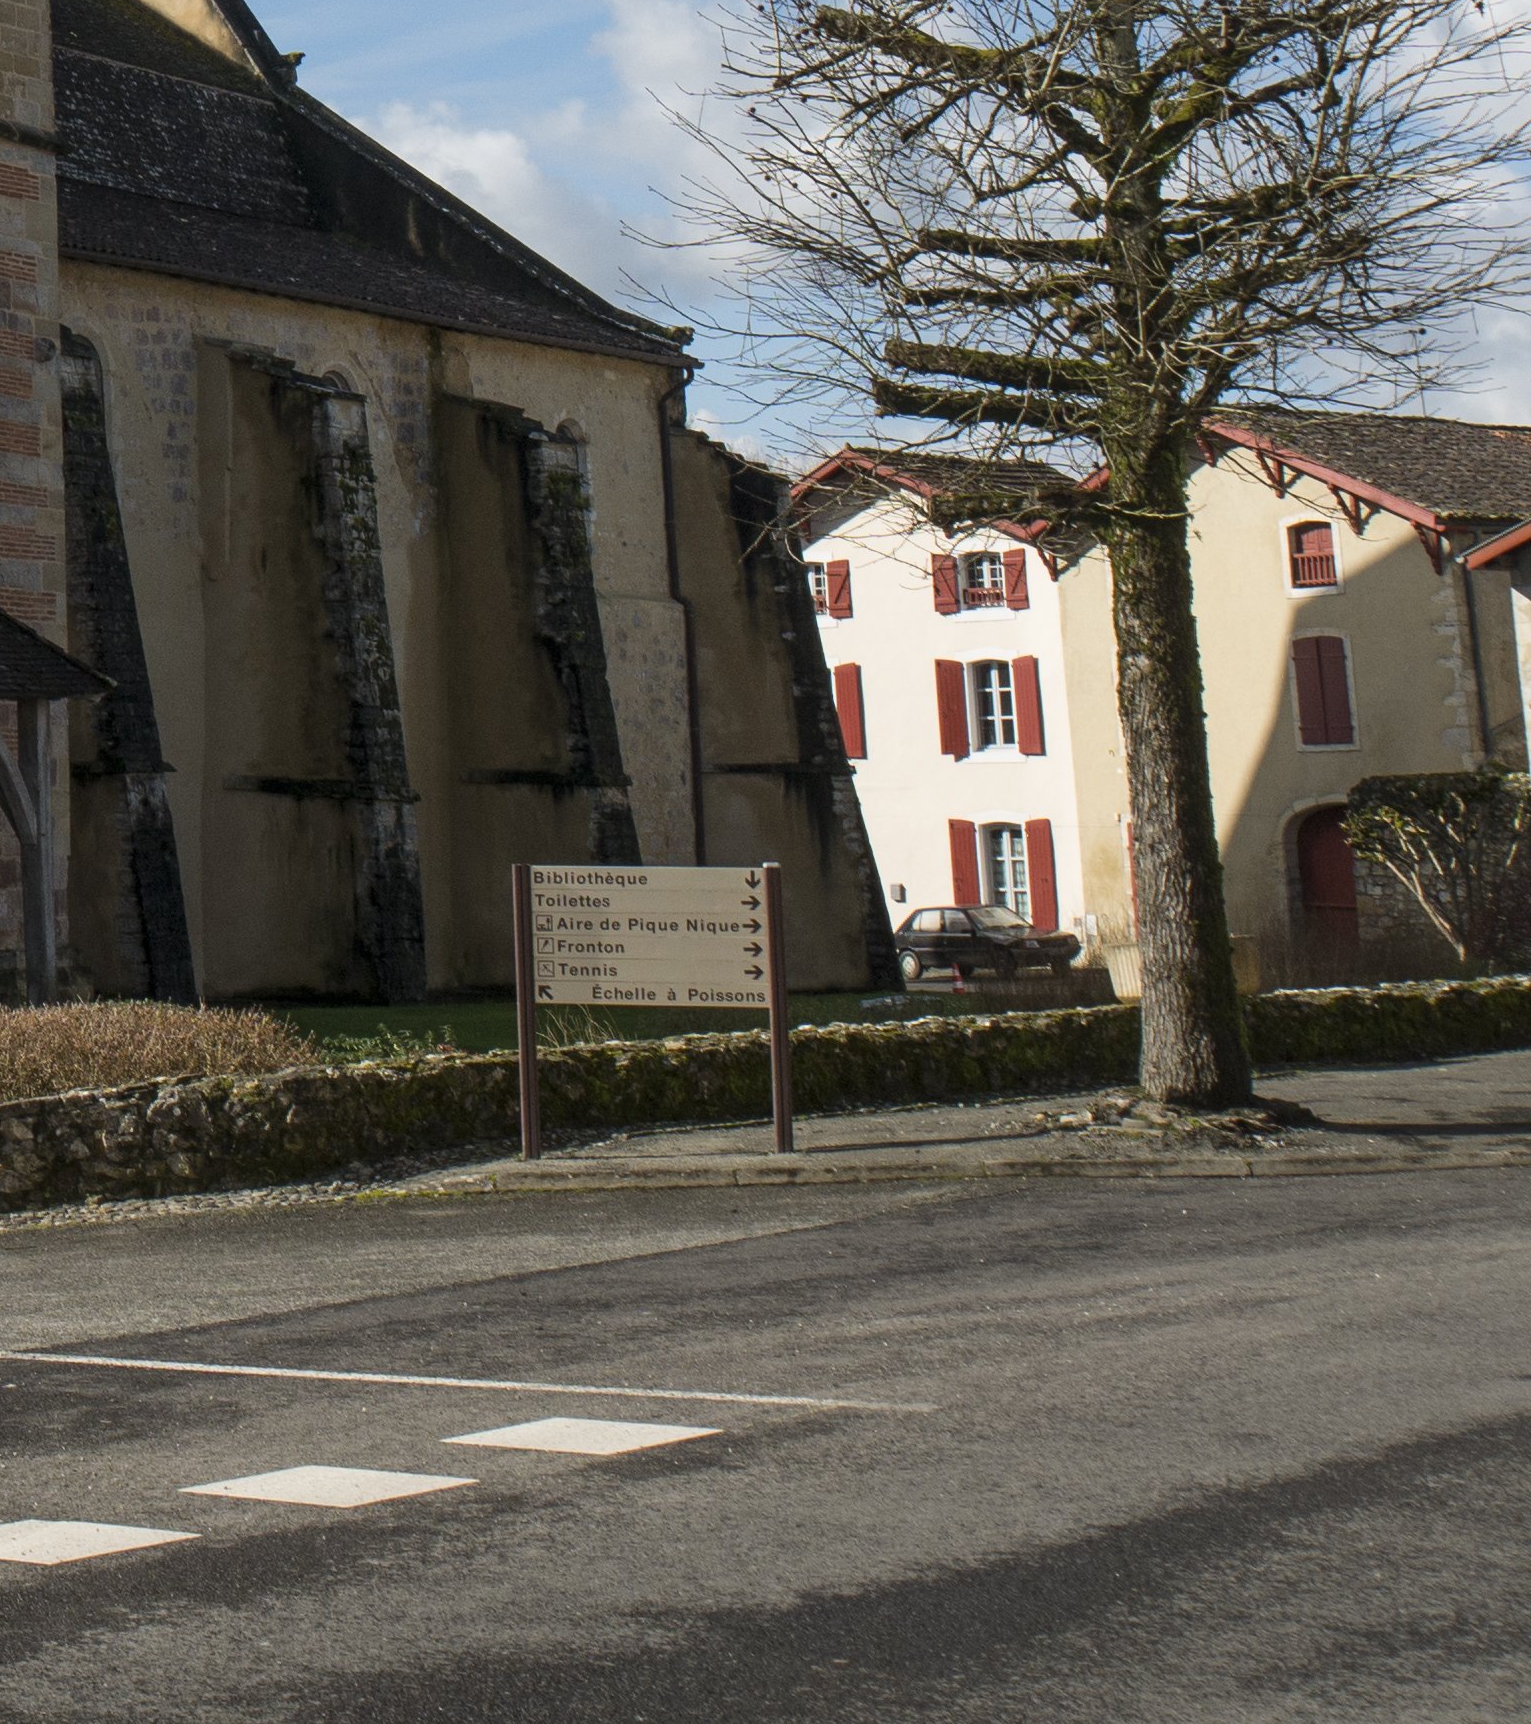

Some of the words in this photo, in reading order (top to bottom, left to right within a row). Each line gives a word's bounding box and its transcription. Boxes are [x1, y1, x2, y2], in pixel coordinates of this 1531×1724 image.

[533, 871, 648, 887] Bibliothèque
[535, 894, 610, 908] Toilettes
[556, 917, 594, 931] Aire
[599, 918, 621, 931] de
[628, 918, 679, 934] Pique
[686, 918, 740, 935] Nique
[557, 940, 625, 953] Fronton
[558, 963, 618, 977] Tennis
[592, 983, 657, 1001] Échelle
[667, 987, 677, 1001] à
[688, 987, 766, 1003] Poissons
